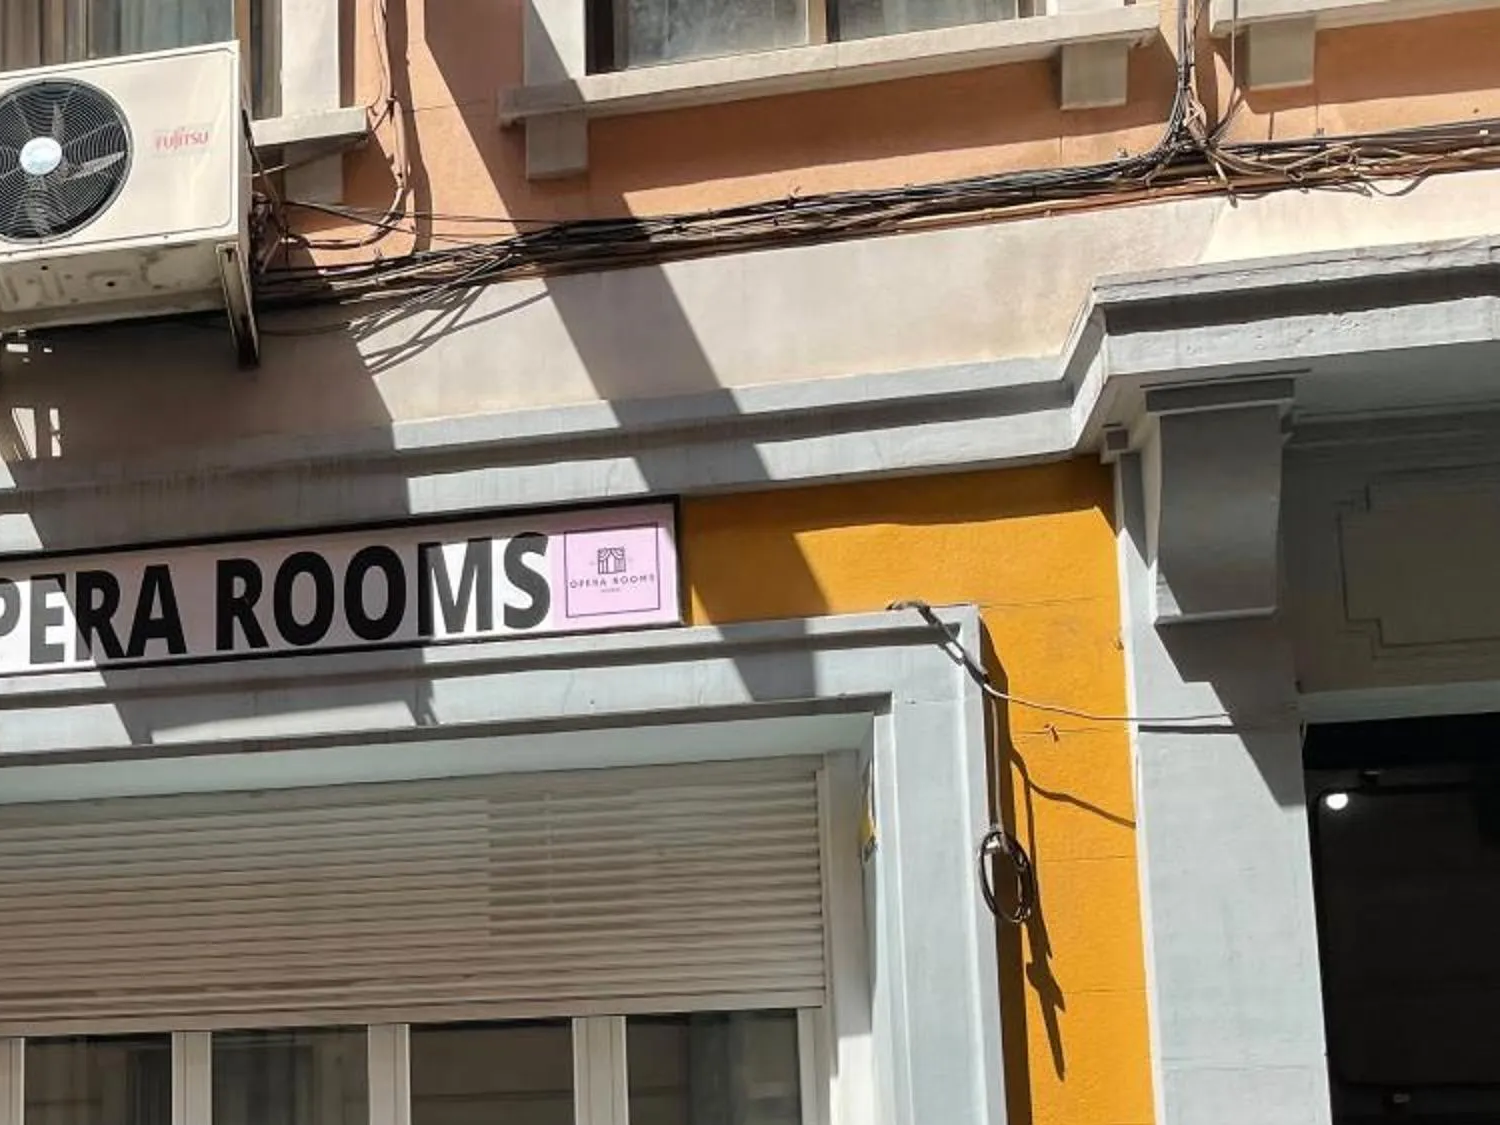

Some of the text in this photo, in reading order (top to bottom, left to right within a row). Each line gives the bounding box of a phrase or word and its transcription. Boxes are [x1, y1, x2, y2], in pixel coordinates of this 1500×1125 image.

[216, 531, 551, 650] ROOMS
[569, 573, 655, 589] OPERA ROOMS
